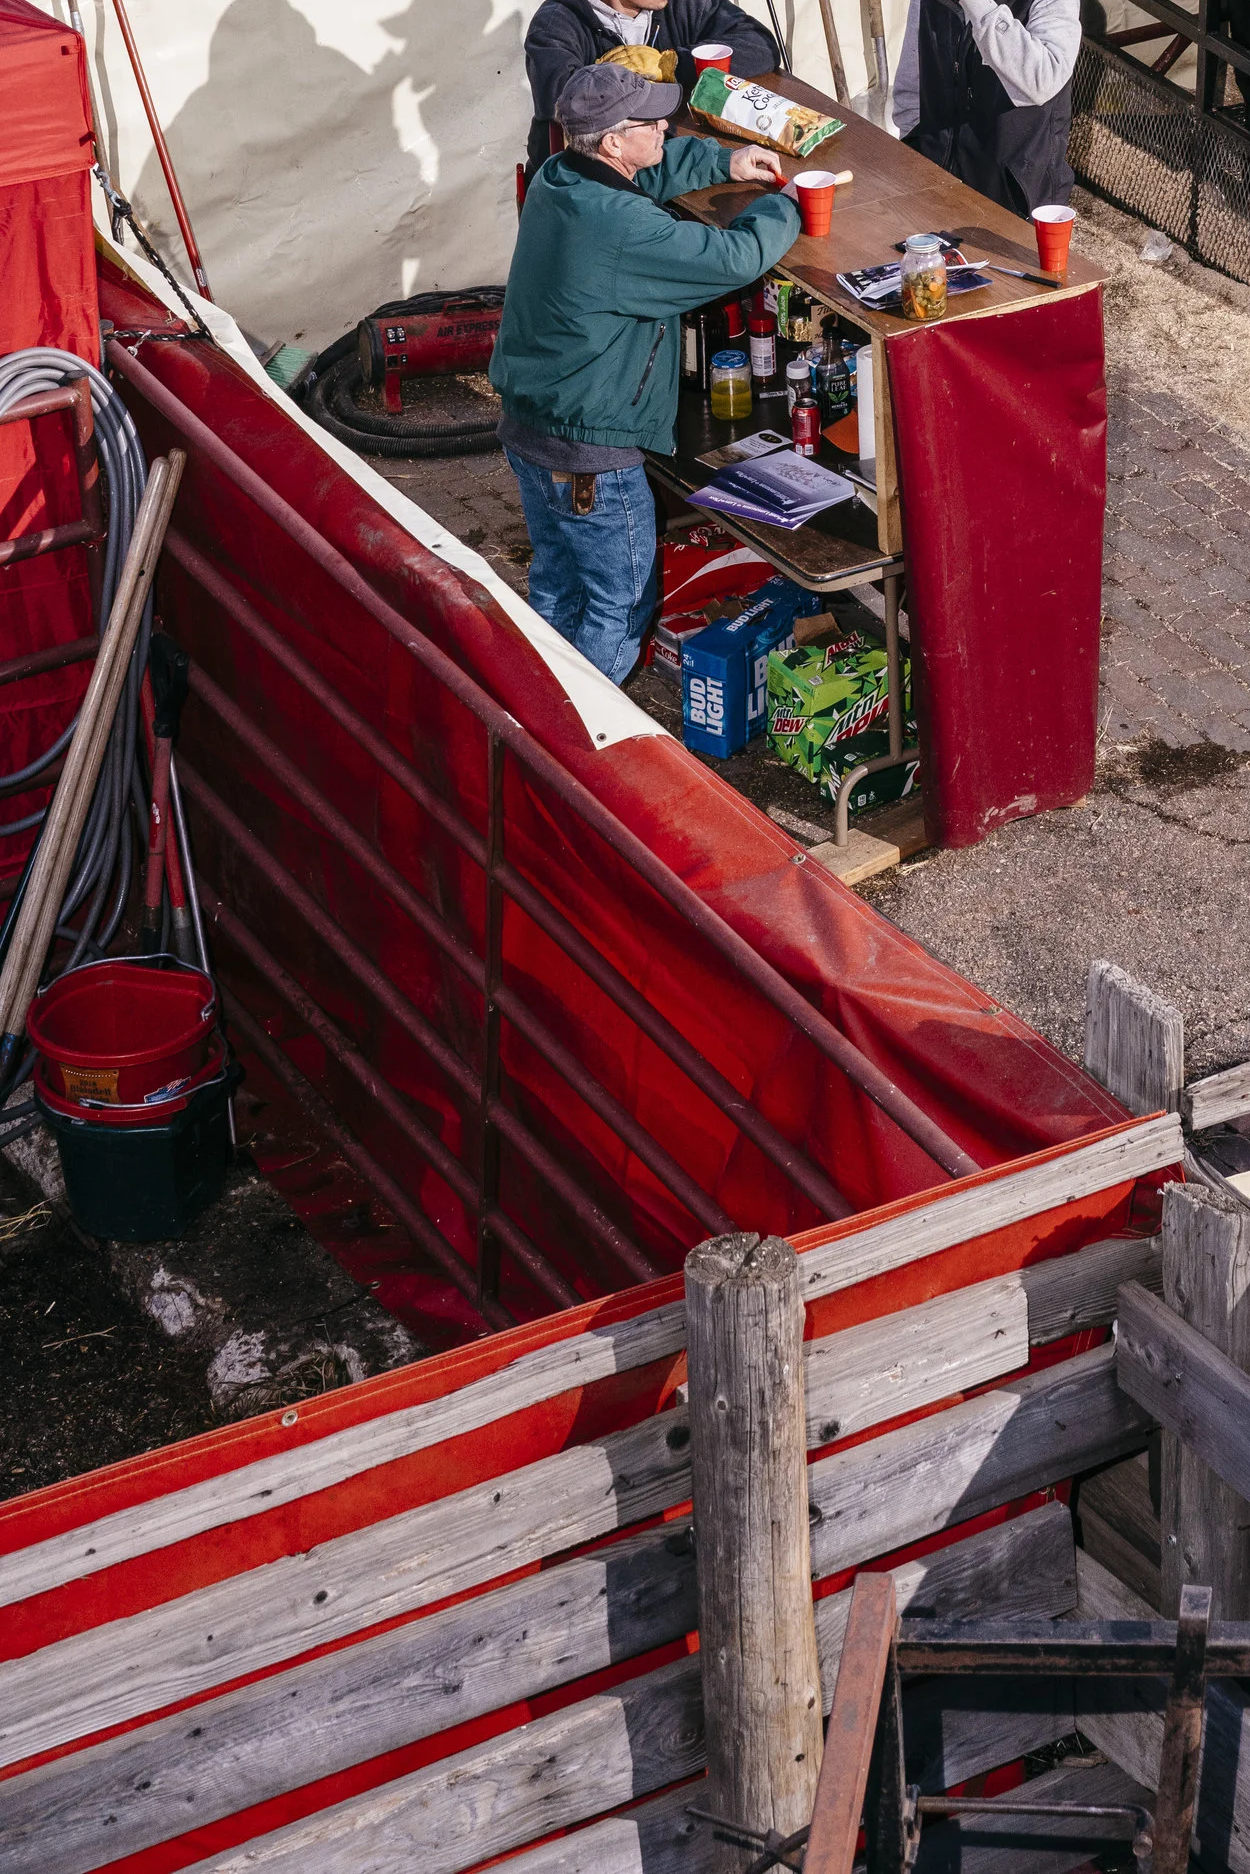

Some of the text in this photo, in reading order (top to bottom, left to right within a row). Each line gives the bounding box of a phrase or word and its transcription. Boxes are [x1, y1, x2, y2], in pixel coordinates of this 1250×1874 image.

[456, 320, 500, 334] EXPRESS
[726, 598, 775, 632] BUD LIGHT
[661, 648, 678, 663] Coke
[683, 654, 689, 665] 24
[690, 677, 706, 725] BUD
[706, 677, 723, 736] LIGHT
[832, 691, 876, 737] Mtn
